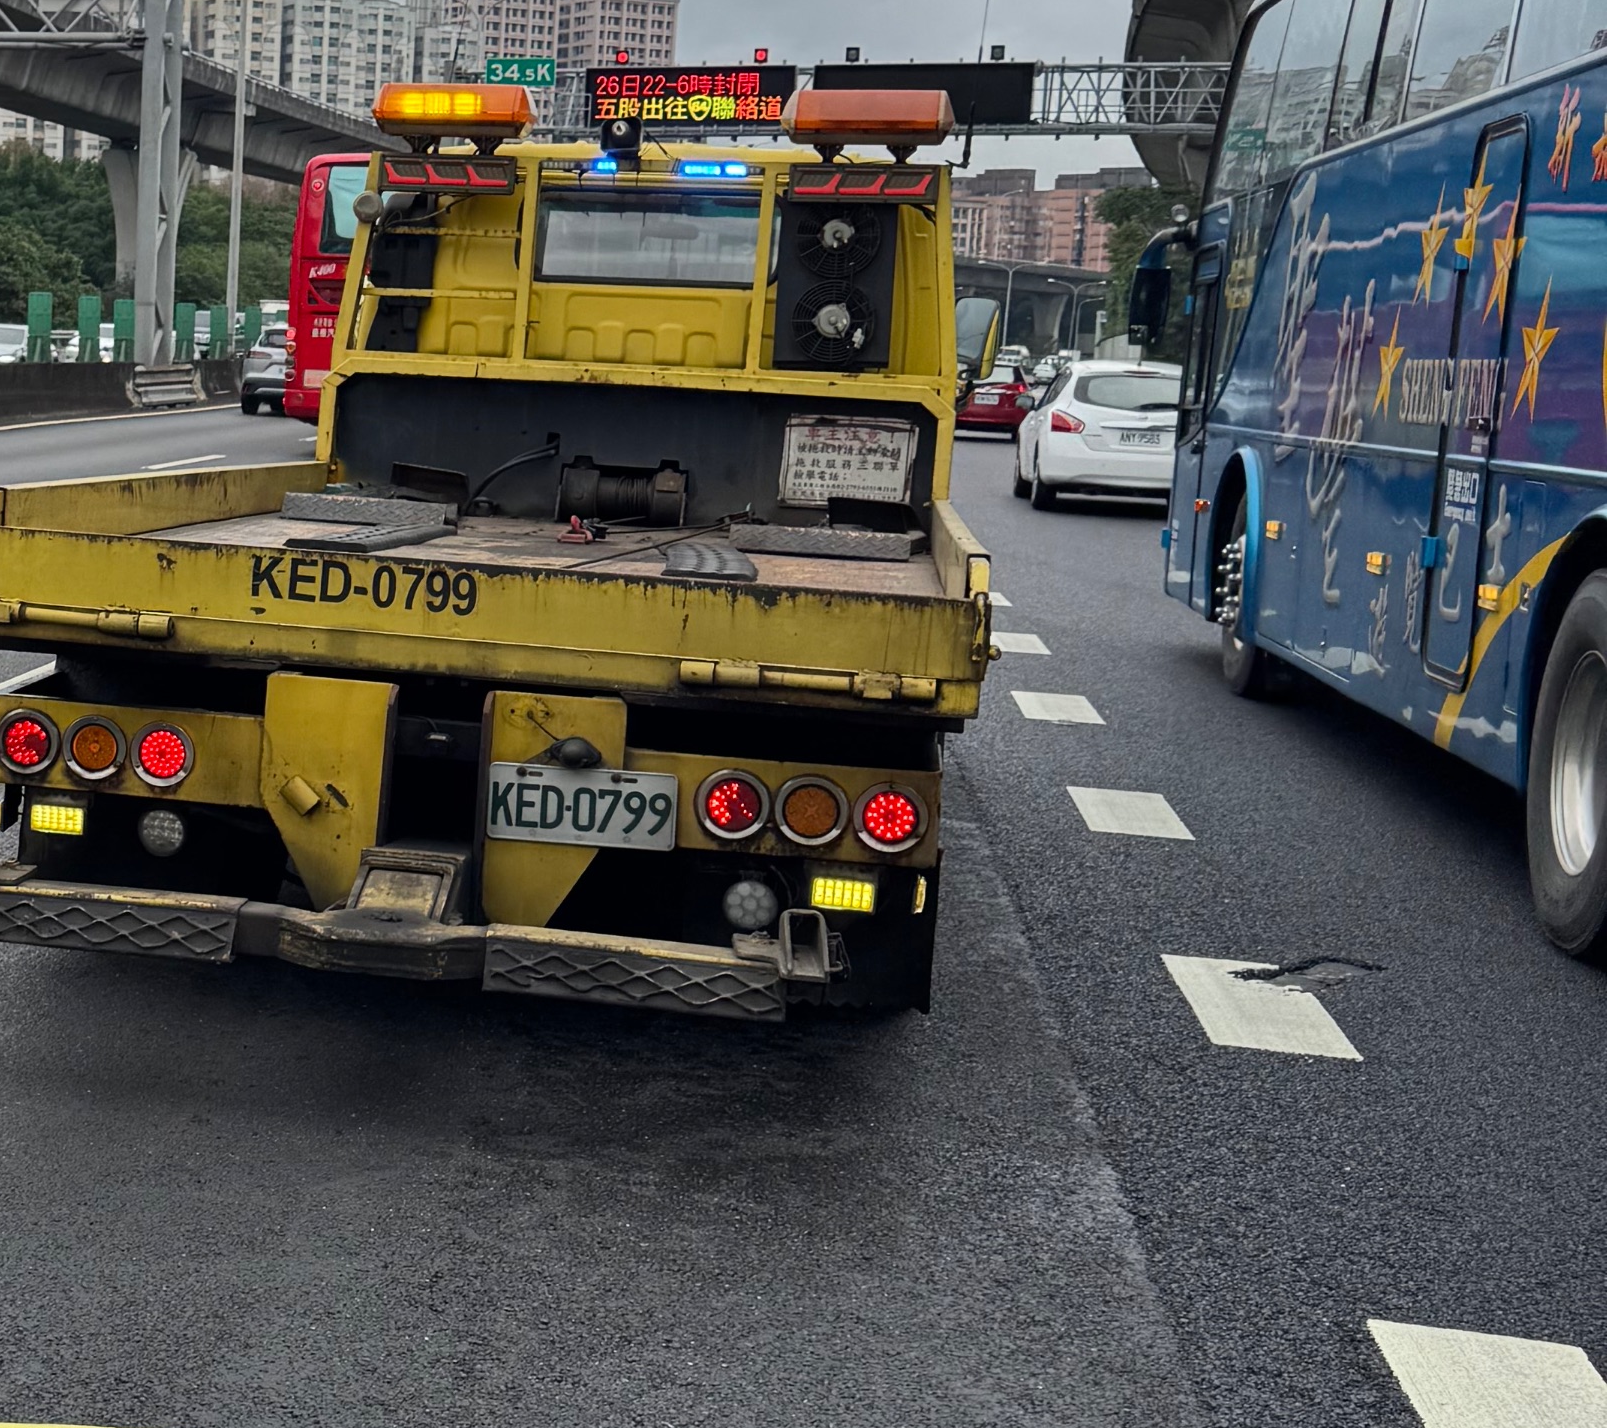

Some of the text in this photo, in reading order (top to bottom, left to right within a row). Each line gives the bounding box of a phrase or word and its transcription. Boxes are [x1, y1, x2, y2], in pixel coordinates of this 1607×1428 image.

[490, 62, 551, 82] 34.5K
[596, 73, 760, 96] 26日22-6時封閉
[251, 555, 477, 616] KED-0799
